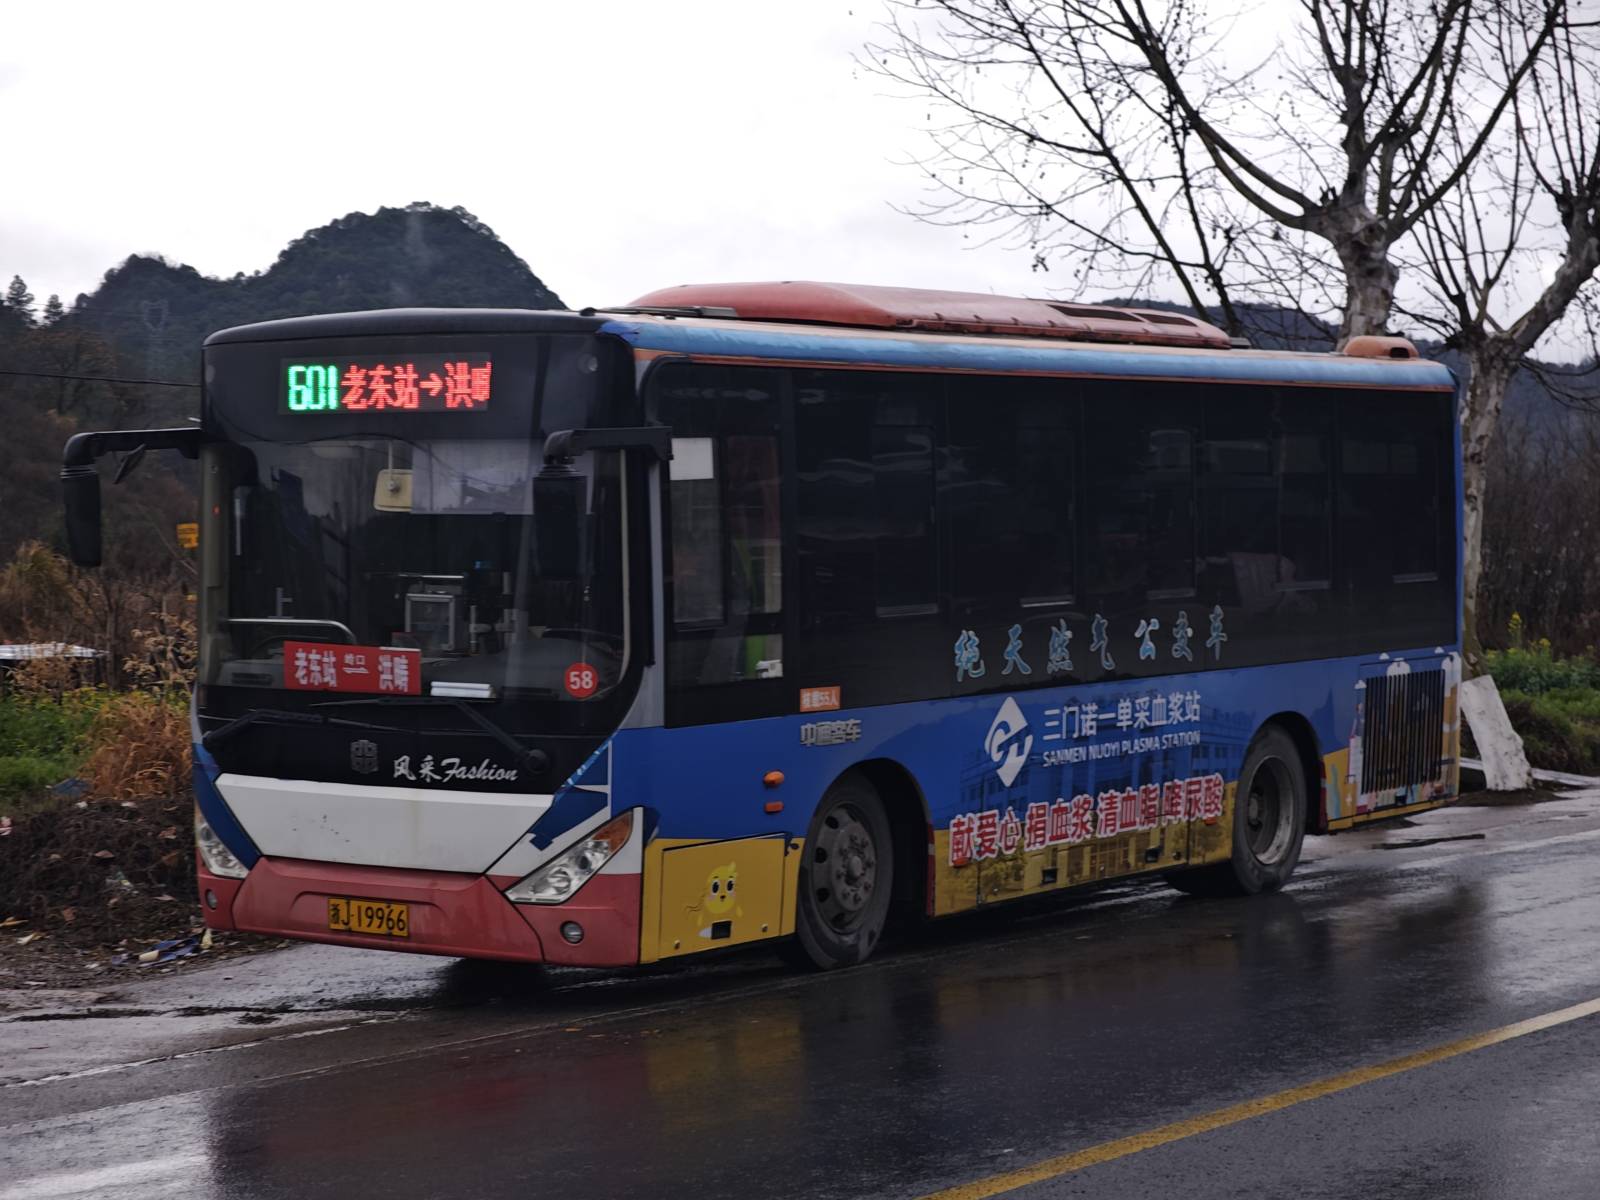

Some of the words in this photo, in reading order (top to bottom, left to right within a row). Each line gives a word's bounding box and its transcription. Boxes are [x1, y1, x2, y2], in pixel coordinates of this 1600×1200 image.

[288, 365, 337, 410] 601
[341, 364, 419, 409] 老东站
[294, 647, 338, 687] 老东站
[569, 670, 593, 690] 58
[1043, 690, 1201, 741] 三门诺一单采血浆站
[1043, 746, 1087, 767] SANMEN
[1088, 741, 1121, 760] NUOYI
[1121, 735, 1161, 755] PLASMA
[1161, 729, 1201, 750] STATION
[393, 754, 442, 783] 风采
[440, 757, 519, 783] Fashion
